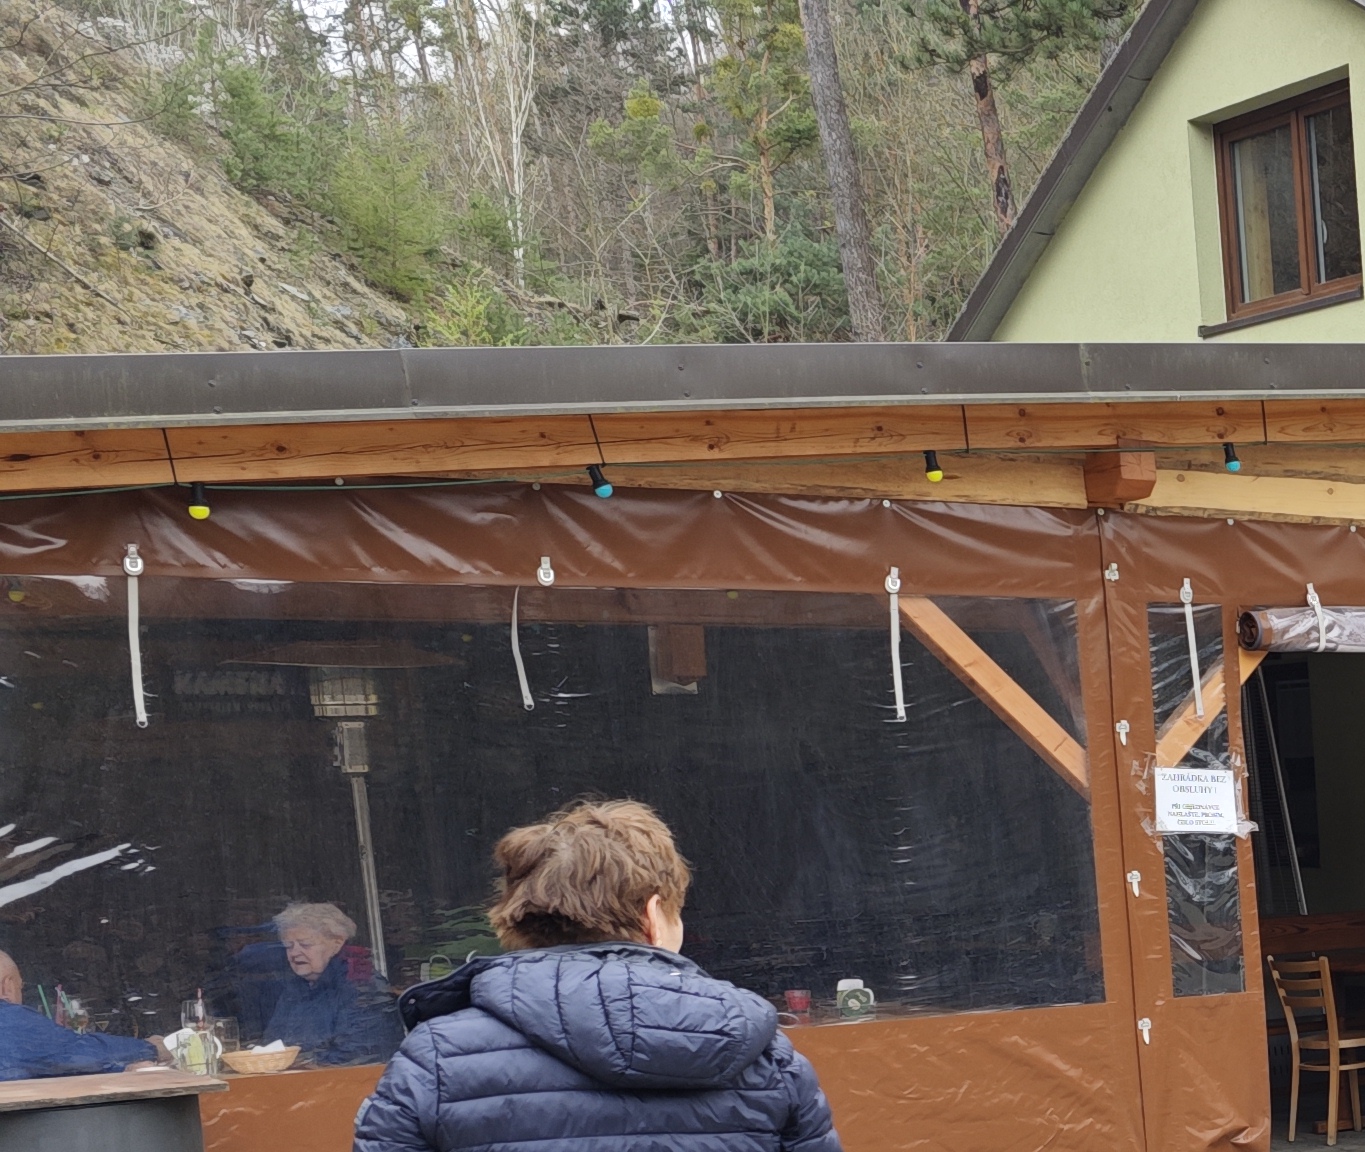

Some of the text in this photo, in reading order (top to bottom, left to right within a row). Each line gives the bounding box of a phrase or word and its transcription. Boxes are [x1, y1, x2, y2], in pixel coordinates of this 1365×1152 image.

[1161, 773, 1227, 784] ZAHRÁDKA BEZ
[1172, 785, 1213, 794] OBSLUHY
